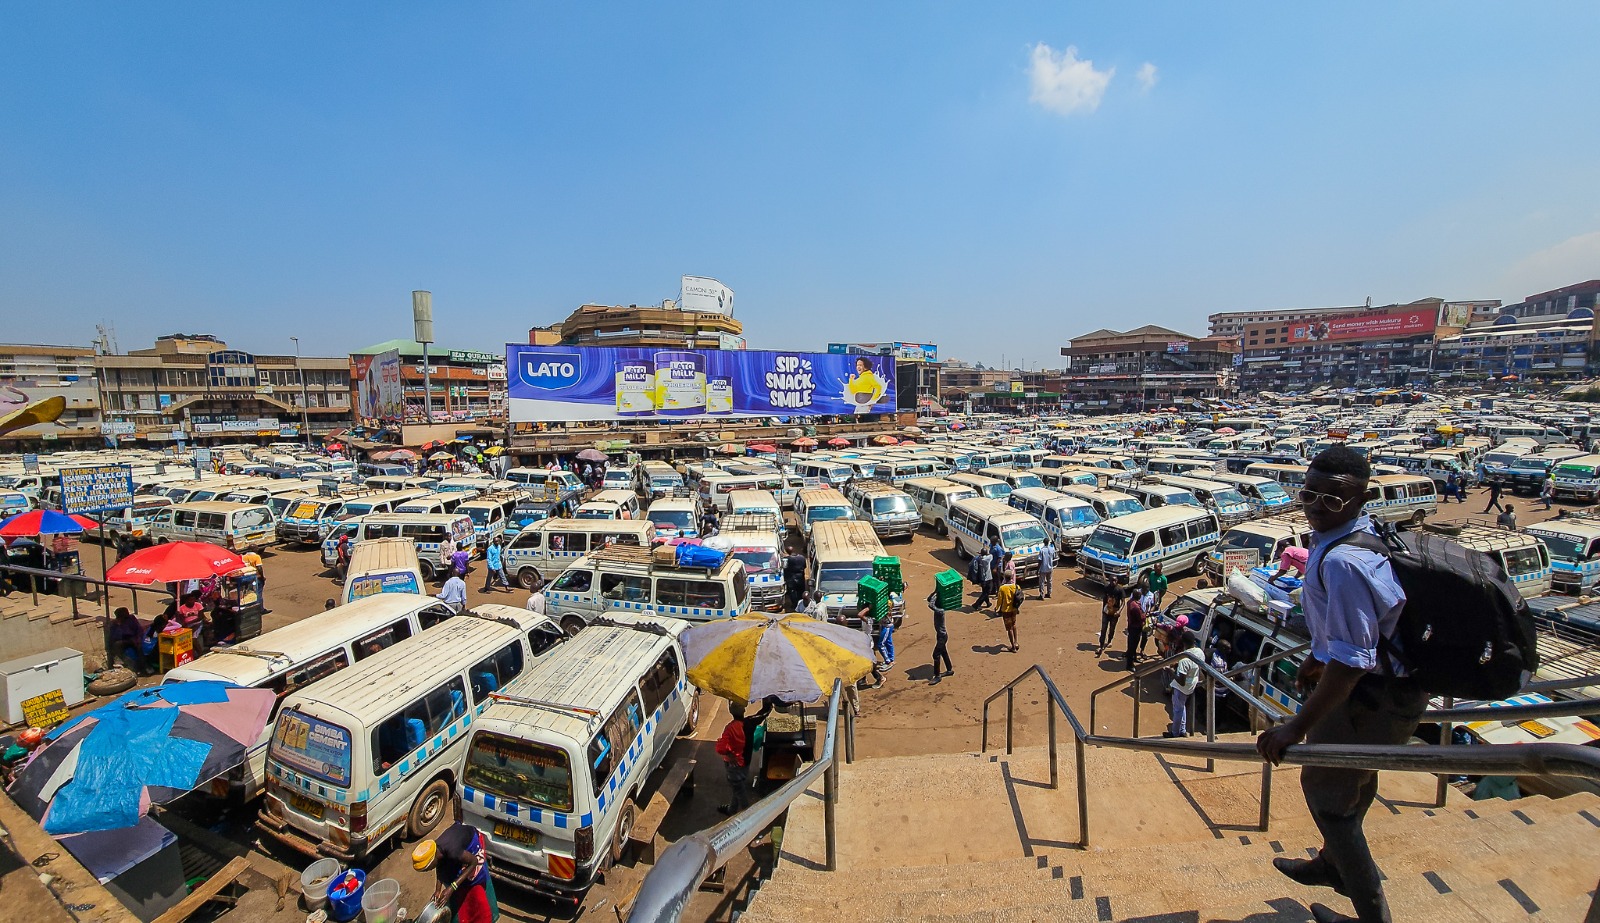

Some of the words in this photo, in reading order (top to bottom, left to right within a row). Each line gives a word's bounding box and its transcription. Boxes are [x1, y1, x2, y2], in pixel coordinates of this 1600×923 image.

[467, 352, 492, 360] QURAN
[527, 362, 575, 378] LATO
[770, 390, 812, 408] SMILE
[94, 472, 116, 480] POLICE
[64, 485, 89, 493] REST
[93, 482, 128, 490] CORNER
[65, 496, 86, 504] HOTEL
[87, 492, 132, 501] INTERNATIONAL
[315, 724, 343, 740] SIMBA
[309, 732, 348, 750] CEMENT
